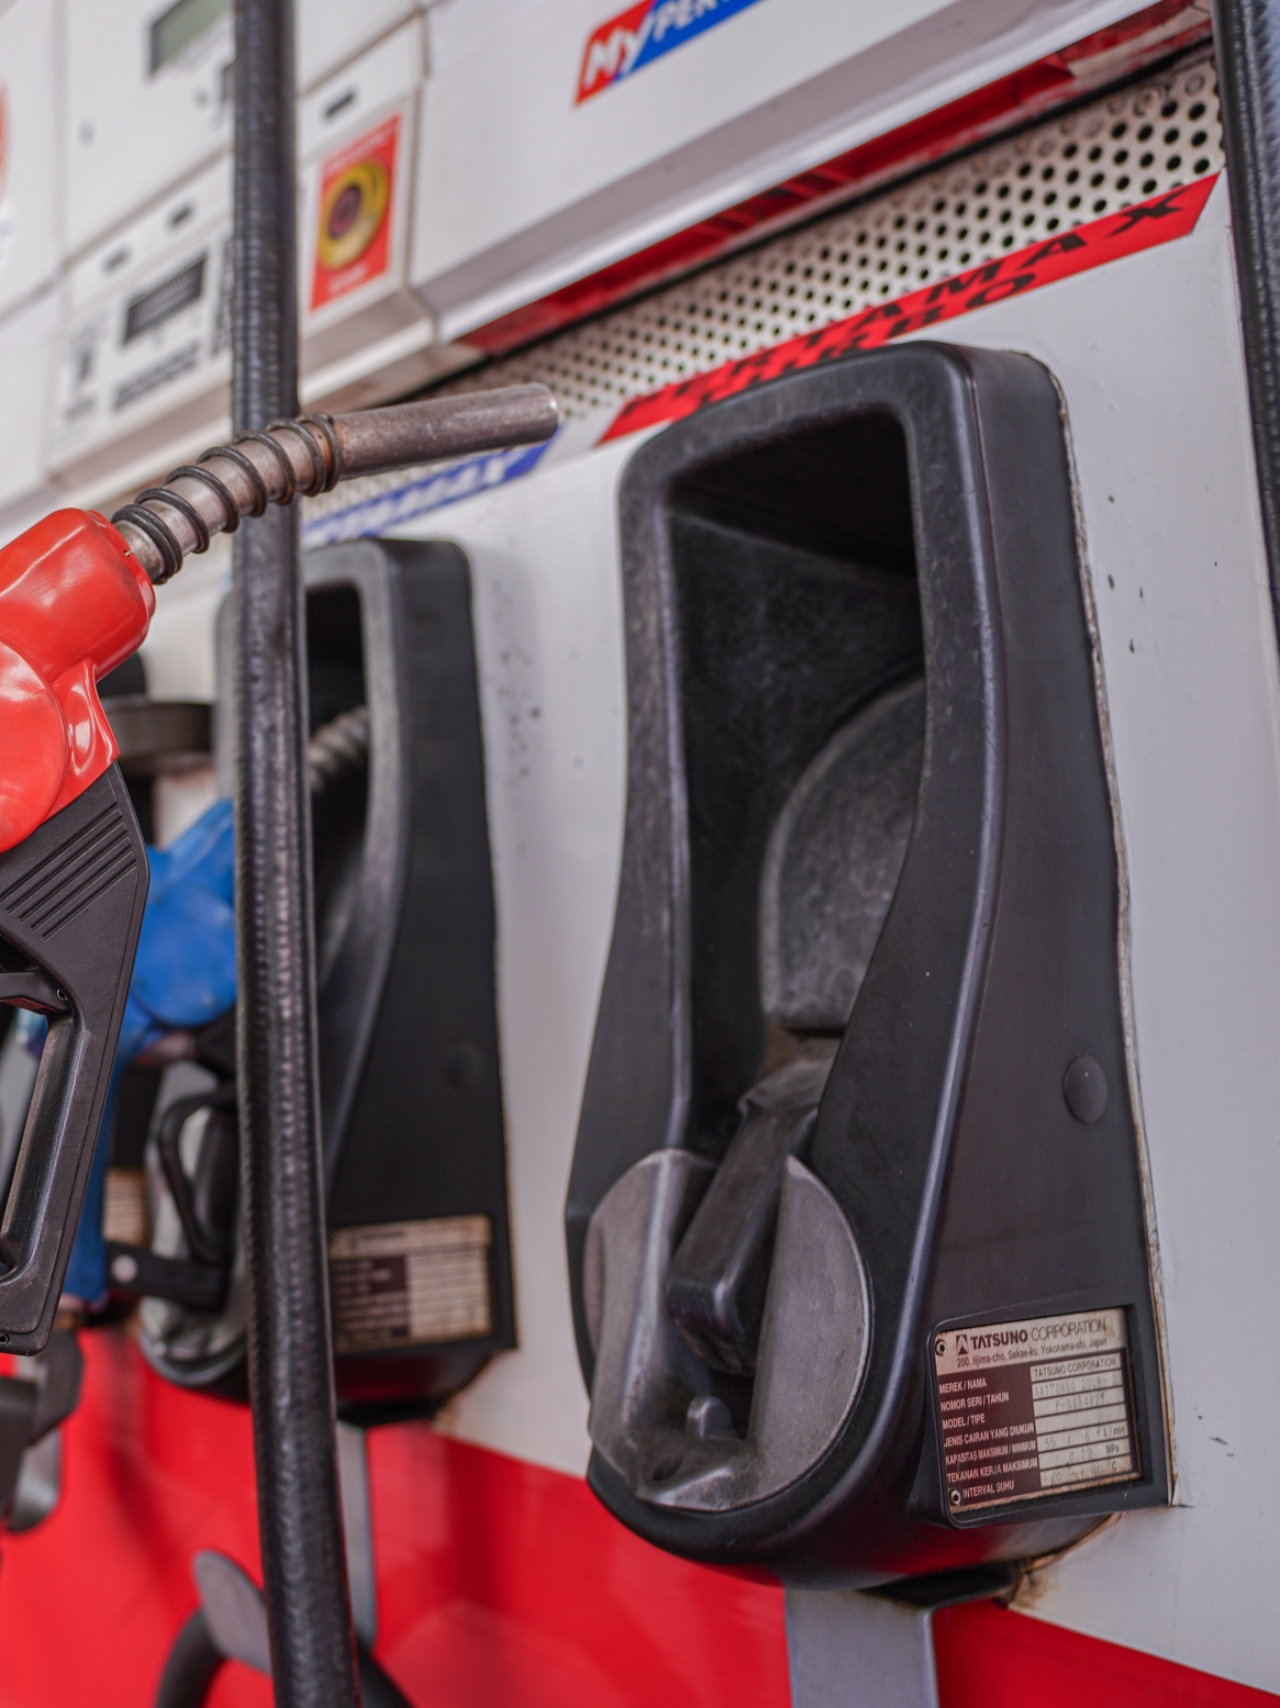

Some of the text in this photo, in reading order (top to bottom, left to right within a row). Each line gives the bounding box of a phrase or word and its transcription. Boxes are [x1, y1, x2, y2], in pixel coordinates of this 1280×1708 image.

[970, 1318, 1107, 1350] TATSUNO CORPORATION
[1033, 1357, 1116, 1378] TATSUNO CORPORATION
[939, 1381, 963, 1394] MEREK
[967, 1377, 987, 1390] NAMA
[941, 1398, 966, 1412] NOMOR
[966, 1396, 982, 1408] SERI
[986, 1391, 1010, 1405] TAHUN
[942, 1417, 966, 1430] MODEL
[970, 1413, 985, 1425] TIPE
[944, 1422, 1035, 1448] JENIS CAIRAN YANG DIUKUR
[945, 1450, 977, 1466] KAPASITAS
[977, 1444, 1009, 1460] MAKSIMUM
[946, 1468, 979, 1483] TEKANAN
[1002, 1457, 1038, 1473] MAKSIMUM
[962, 1480, 1015, 1498] INTERVAL SUHU
